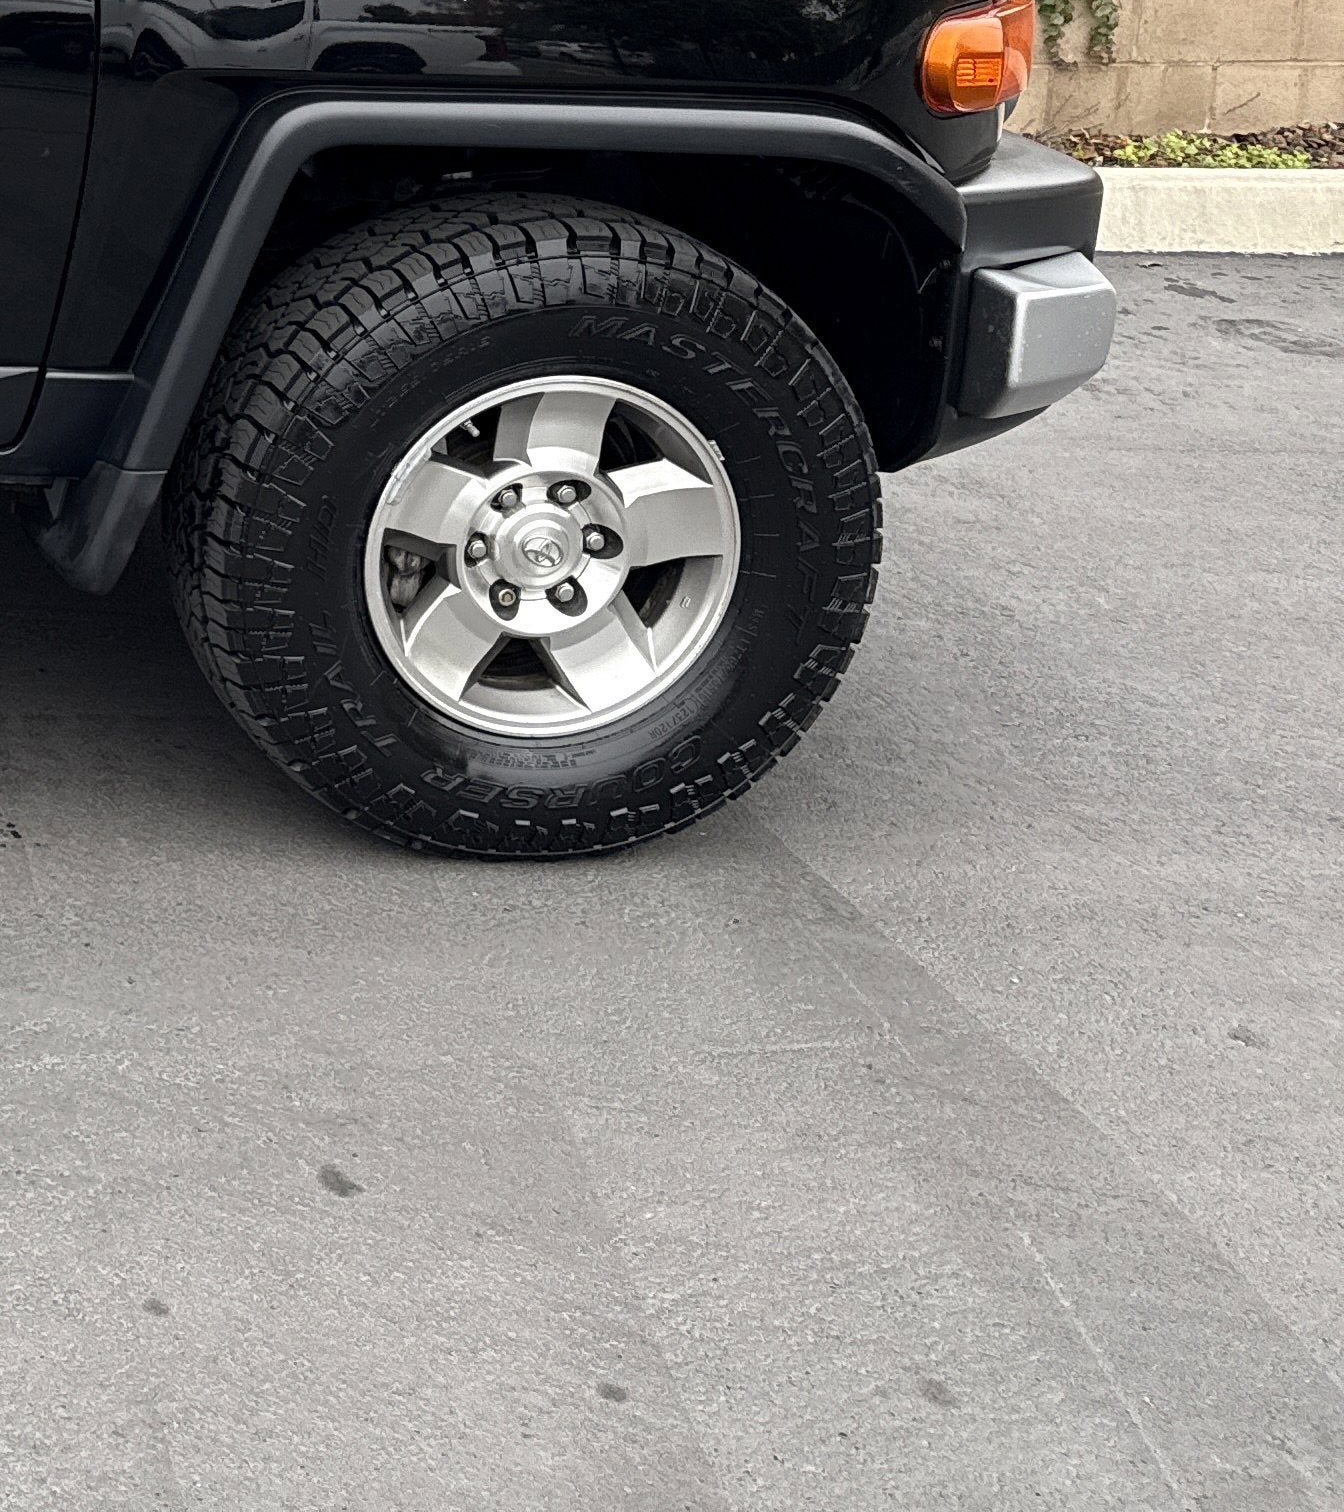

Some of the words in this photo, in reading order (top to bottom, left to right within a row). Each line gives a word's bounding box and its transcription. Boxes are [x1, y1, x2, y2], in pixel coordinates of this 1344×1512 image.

[569, 315, 821, 646] MASTERCRAFT
[310, 608, 399, 758] TRAIL
[422, 737, 705, 809] COURSER
